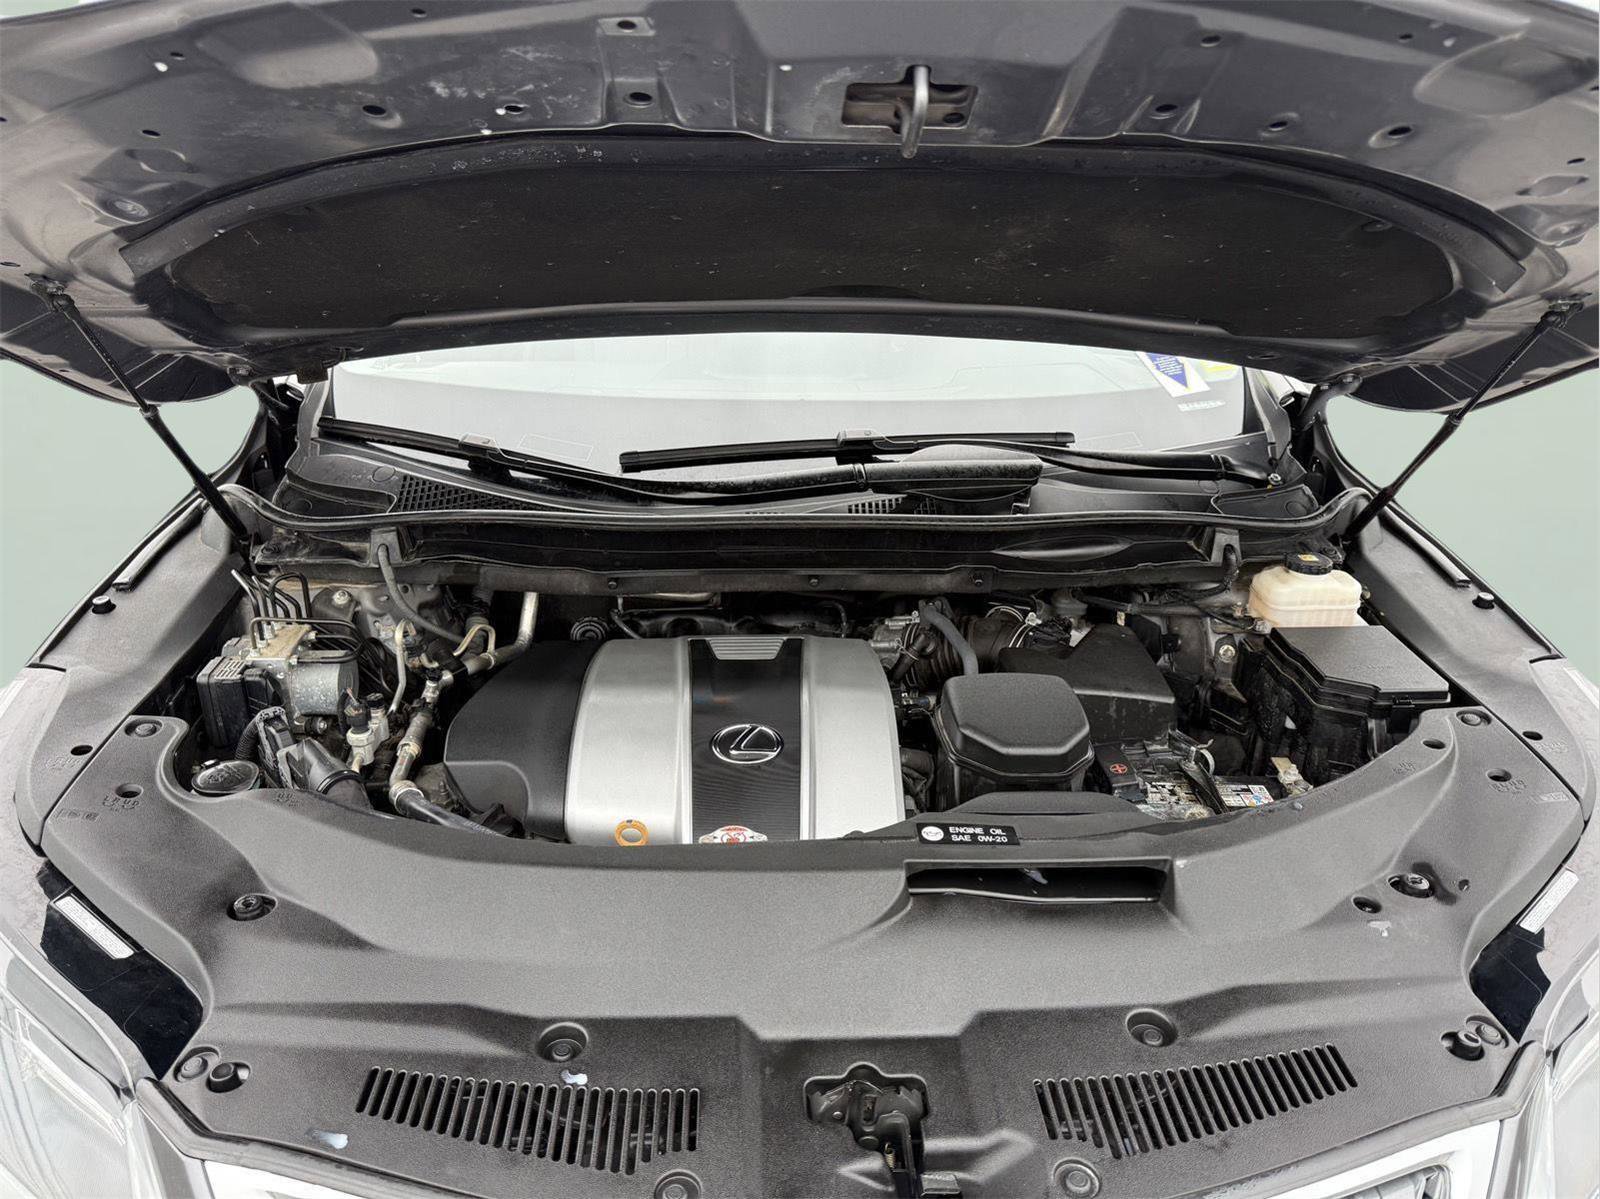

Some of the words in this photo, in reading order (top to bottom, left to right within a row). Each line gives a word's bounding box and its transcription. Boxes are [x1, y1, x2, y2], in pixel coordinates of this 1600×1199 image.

[948, 826, 985, 835] ENGINE
[989, 828, 1007, 836] OIL
[951, 834, 972, 842] SAE
[977, 835, 1008, 843] 0W-20
